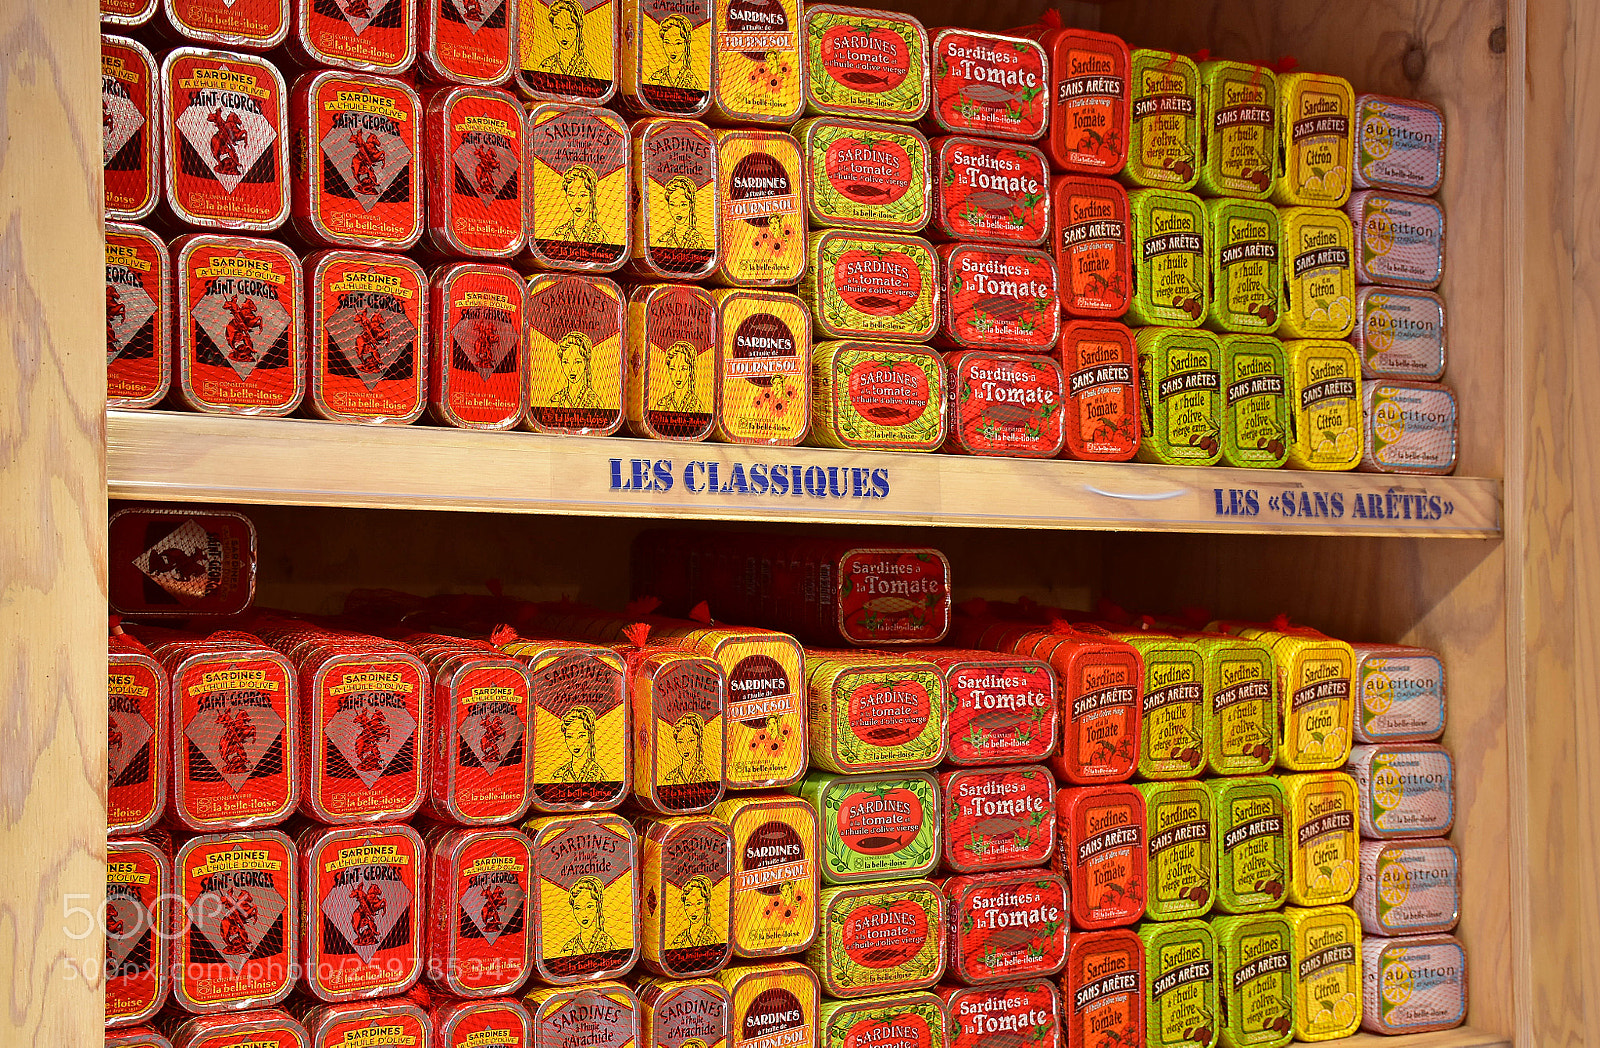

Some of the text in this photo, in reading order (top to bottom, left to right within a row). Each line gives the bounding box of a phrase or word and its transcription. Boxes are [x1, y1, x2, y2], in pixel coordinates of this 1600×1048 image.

[730, 8, 784, 25] SARDINES
[725, 34, 792, 48] TOURNESOL
[833, 36, 897, 56] SARDINES
[847, 51, 889, 64] tomate
[948, 43, 1010, 63] Sardines
[960, 60, 1036, 88] Tomate
[1071, 58, 1111, 75] Sardines
[196, 70, 254, 84] SARDINES
[1060, 82, 1082, 98] SANS
[340, 92, 392, 106] SARDINES
[1136, 100, 1158, 113] SANS
[466, 118, 506, 128] SARDINES
[1073, 111, 1106, 128] Tomate
[545, 122, 614, 146] SARDINES
[1366, 124, 1432, 143] au citron
[649, 136, 710, 159] SARDINES
[838, 149, 900, 168] SARDINES
[954, 151, 1013, 171] Sardines
[851, 163, 892, 176] tomate
[734, 176, 786, 189] SARDINES
[966, 167, 1037, 194] Tomate
[1154, 216, 1191, 231] Sardines
[1064, 228, 1086, 243] SANS
[1146, 240, 1167, 254] SANS
[212, 258, 269, 270] SARDINES
[847, 260, 909, 279] SARDINES
[962, 257, 1022, 276] Sardines
[1079, 258, 1110, 274] Tomate
[1296, 255, 1316, 270] SANS
[346, 274, 398, 286] SARDINES
[859, 276, 902, 287] tomate
[974, 274, 1048, 299] Tomate
[466, 293, 507, 302] SARDINES
[1309, 283, 1335, 298] Citron
[737, 335, 792, 350] SARDINES
[1081, 348, 1119, 364] Sardines
[860, 370, 918, 388] SARDINES
[970, 366, 1028, 384] Sardines
[1072, 373, 1095, 389] SANS
[872, 386, 911, 397] tomate
[982, 381, 1054, 404] Tomate
[1162, 379, 1183, 395] SANS
[609, 458, 890, 499] LES CLASSIQUES
[1214, 488, 1260, 516] LES
[852, 562, 913, 575] Sardines
[865, 575, 938, 597] Tomate
[205, 671, 263, 682] SARDINES
[346, 674, 399, 684] SARDINES
[731, 678, 786, 691] SARDINES
[958, 675, 1019, 690] Sardines
[1366, 678, 1434, 690] au citron
[473, 688, 512, 696] SARDINES
[860, 691, 918, 708] SARDINES
[970, 690, 1046, 710] Tomate
[1216, 692, 1236, 707] SANS
[1293, 689, 1316, 706] SANS
[872, 705, 911, 716] tomate
[1074, 696, 1098, 714] SANS
[1087, 723, 1119, 742] Tomate
[1306, 716, 1332, 733] Citron
[959, 783, 1018, 798] Sardines
[850, 800, 910, 817] SARDINES
[971, 796, 1044, 818] Tomate
[862, 813, 903, 825] tomate
[896, 824, 919, 834] vierge
[342, 846, 394, 858] SARDINES
[550, 834, 618, 860] SARDINES
[746, 844, 800, 858] SARDINES
[1080, 839, 1102, 858] SANS
[210, 851, 265, 862] SARDINES
[475, 856, 514, 867] SARDINES
[872, 858, 907, 868] belle-iloise
[1094, 866, 1126, 886] Tomate
[972, 892, 1031, 910] Sardines
[854, 912, 916, 931] SARDINES
[985, 904, 1058, 928] Tomate
[867, 926, 908, 938] tomate
[1308, 931, 1344, 951] Sardines
[1164, 945, 1200, 968] Sardines
[1235, 967, 1256, 985] SANS
[1385, 966, 1455, 980] au citron
[1154, 976, 1176, 994] SANS
[1314, 981, 1340, 999] Citron
[1077, 987, 1100, 1006] SANS
[660, 1000, 724, 1024] SARDINES
[960, 997, 1021, 1015] Sardines
[552, 1005, 622, 1034] SARDINES
[746, 1010, 800, 1027] SARDINES
[972, 1008, 1047, 1033] Tomate
[347, 1026, 401, 1041] SARDINES
